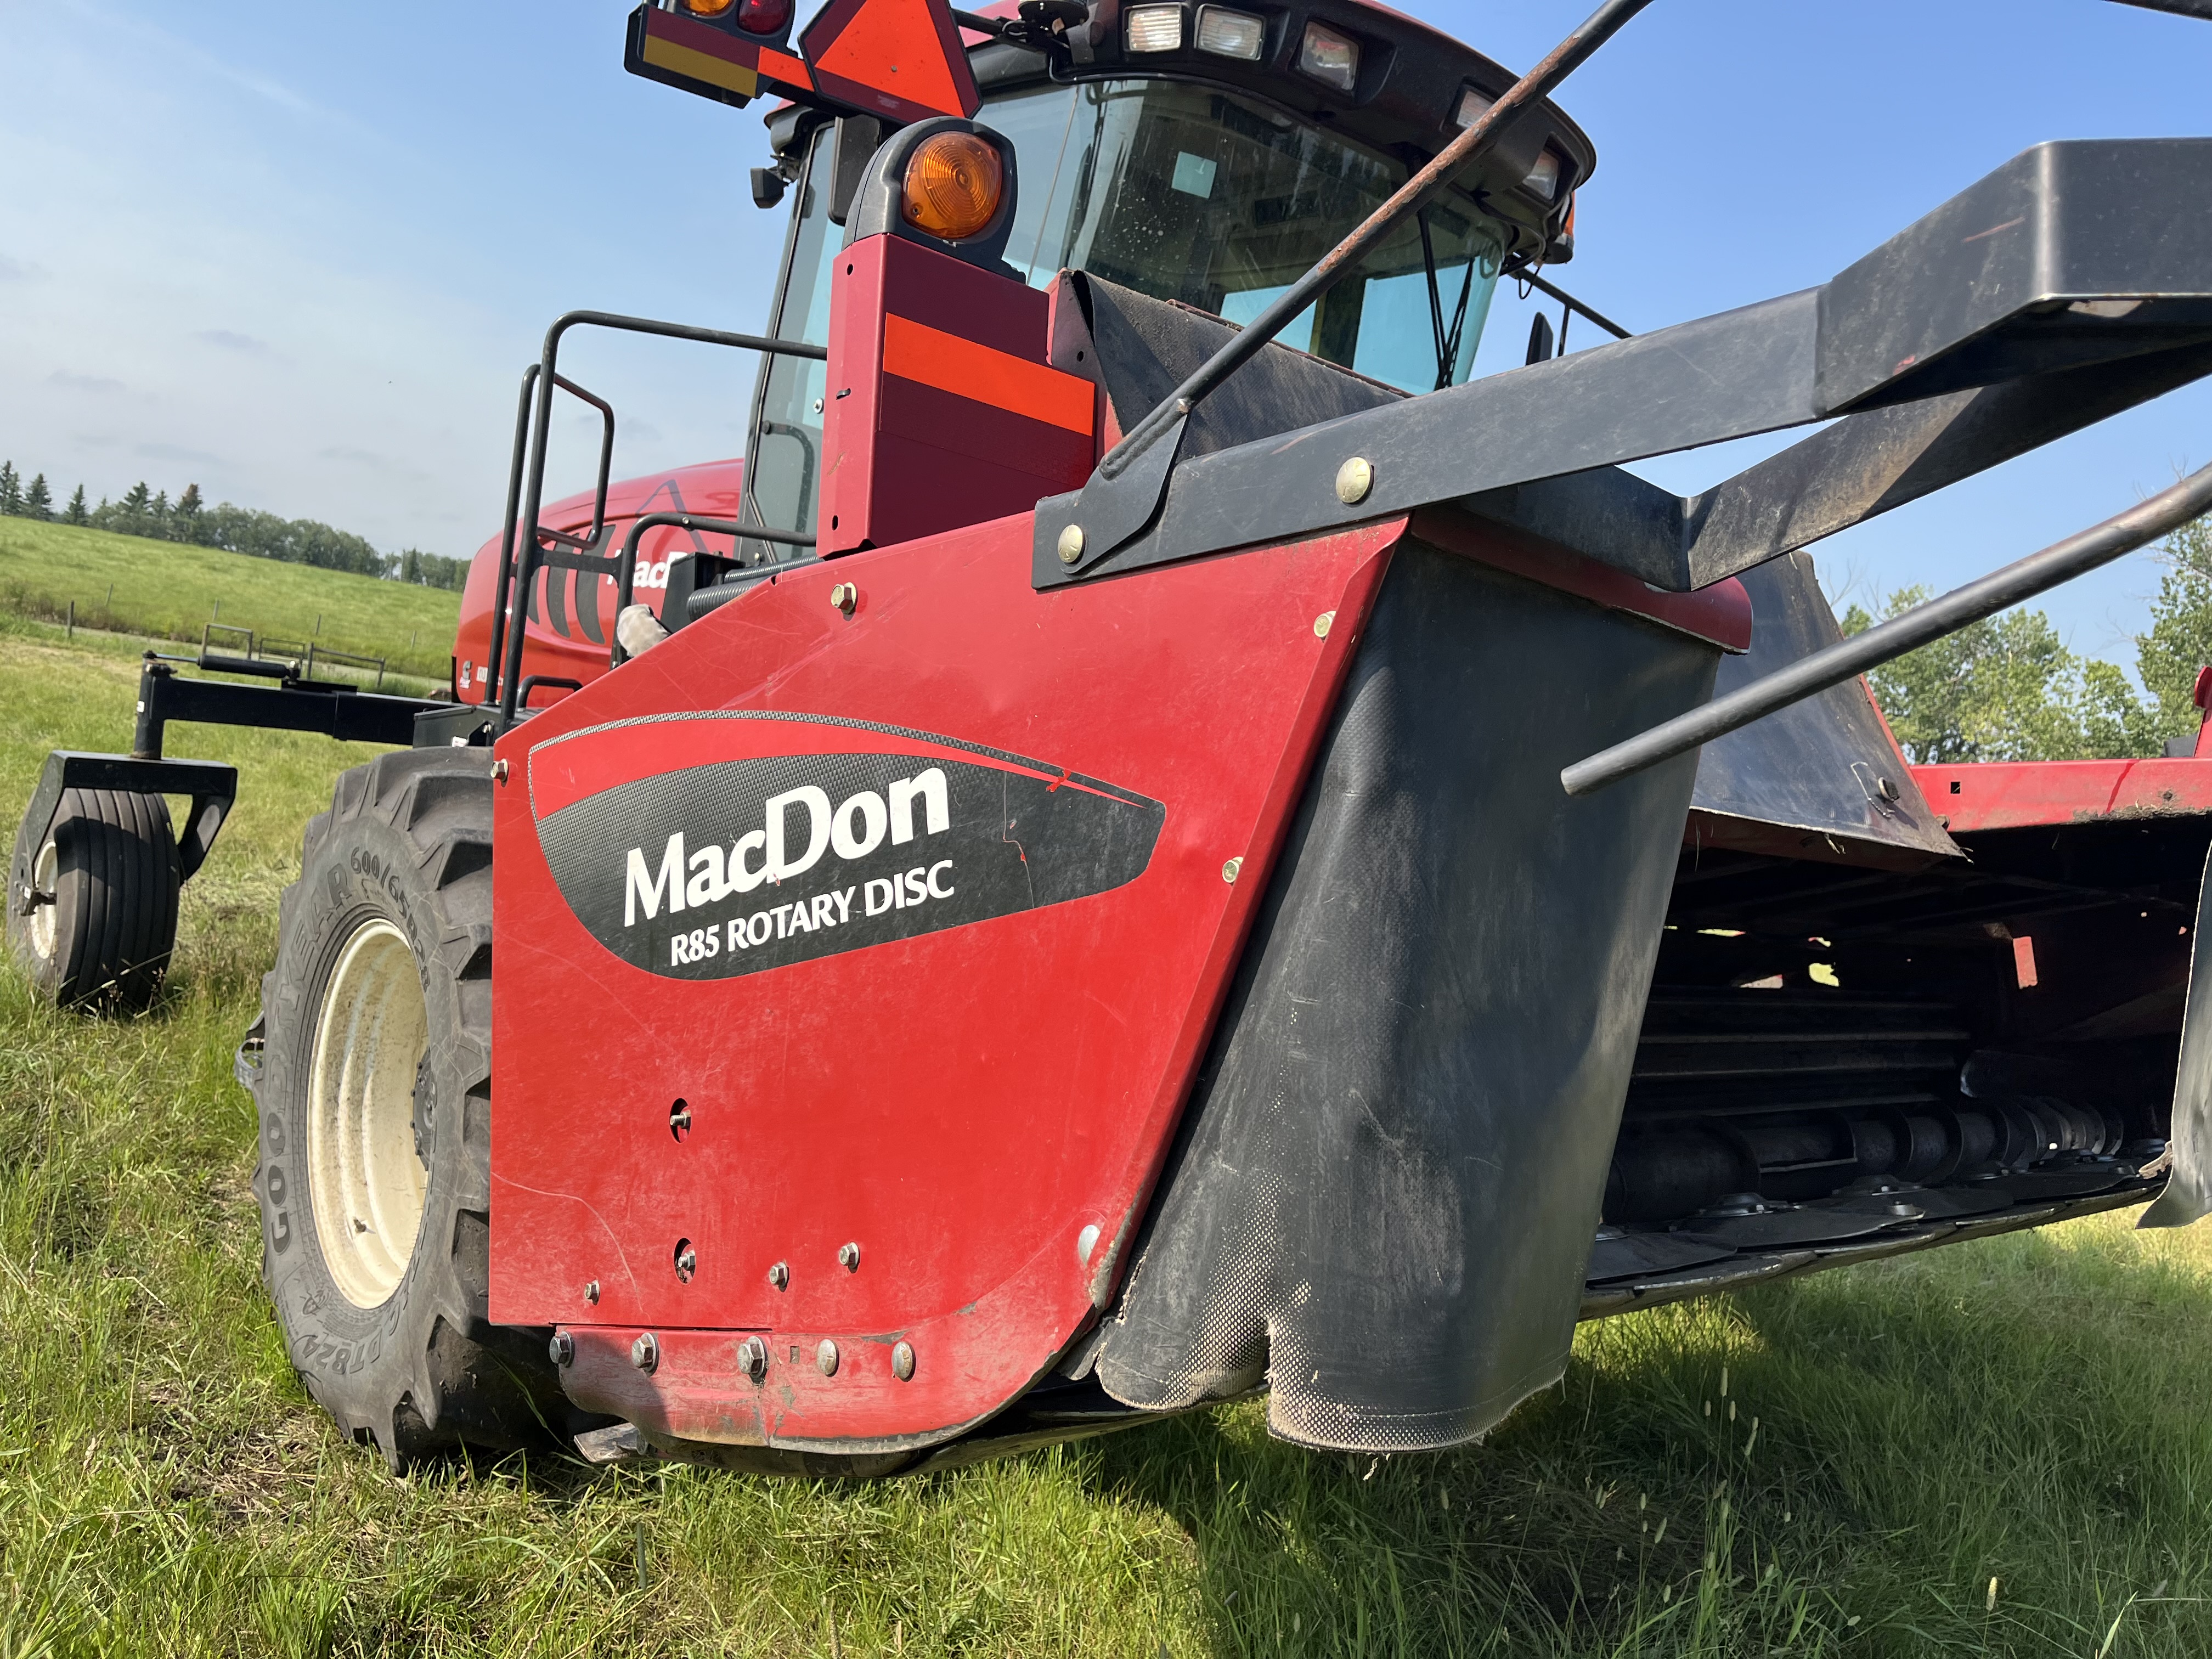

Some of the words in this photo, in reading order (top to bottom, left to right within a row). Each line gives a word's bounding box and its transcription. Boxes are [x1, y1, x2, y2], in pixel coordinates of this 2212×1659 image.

[624, 767, 951, 927] MacDon
[670, 925, 720, 967] R85
[727, 885, 856, 952] ROTARY
[864, 859, 955, 916] DISC
